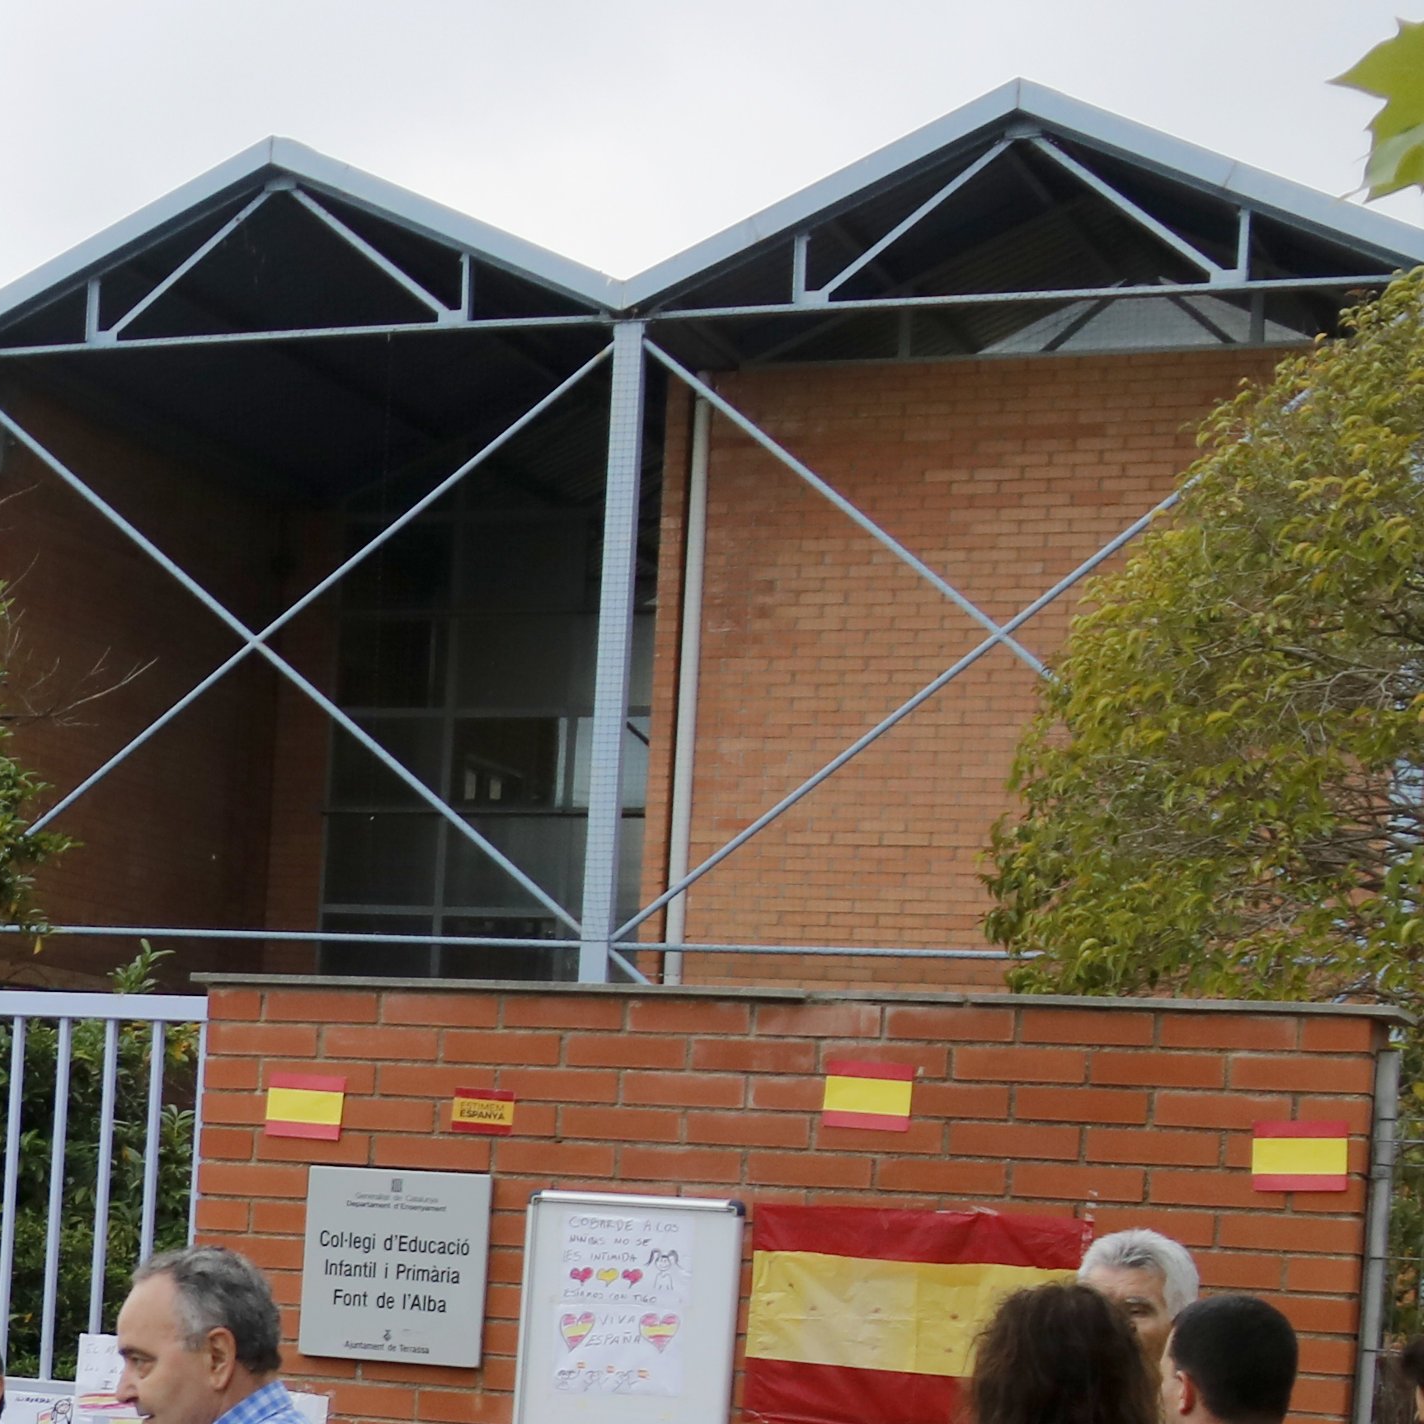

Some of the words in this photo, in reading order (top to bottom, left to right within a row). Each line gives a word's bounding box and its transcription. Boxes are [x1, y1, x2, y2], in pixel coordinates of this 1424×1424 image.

[460, 1109, 505, 1120] ESPANYA
[346, 1200, 391, 1209] Departament
[569, 1216, 634, 1232] COBARDE
[320, 1230, 376, 1254] Col·legi
[384, 1234, 470, 1256] d'Educació
[614, 1237, 630, 1246] NO
[324, 1259, 376, 1278] Infantil
[384, 1263, 388, 1279] i
[396, 1263, 460, 1284] Primària
[333, 1289, 368, 1307] Font
[376, 1292, 395, 1309] de
[402, 1293, 447, 1313] l'Alba
[599, 1314, 636, 1326] VIVA
[585, 1331, 641, 1347] ESPAÑA
[344, 1340, 385, 1351] Ajuntament
[388, 1343, 396, 1352] de
[399, 1344, 430, 1354] Terrassa
